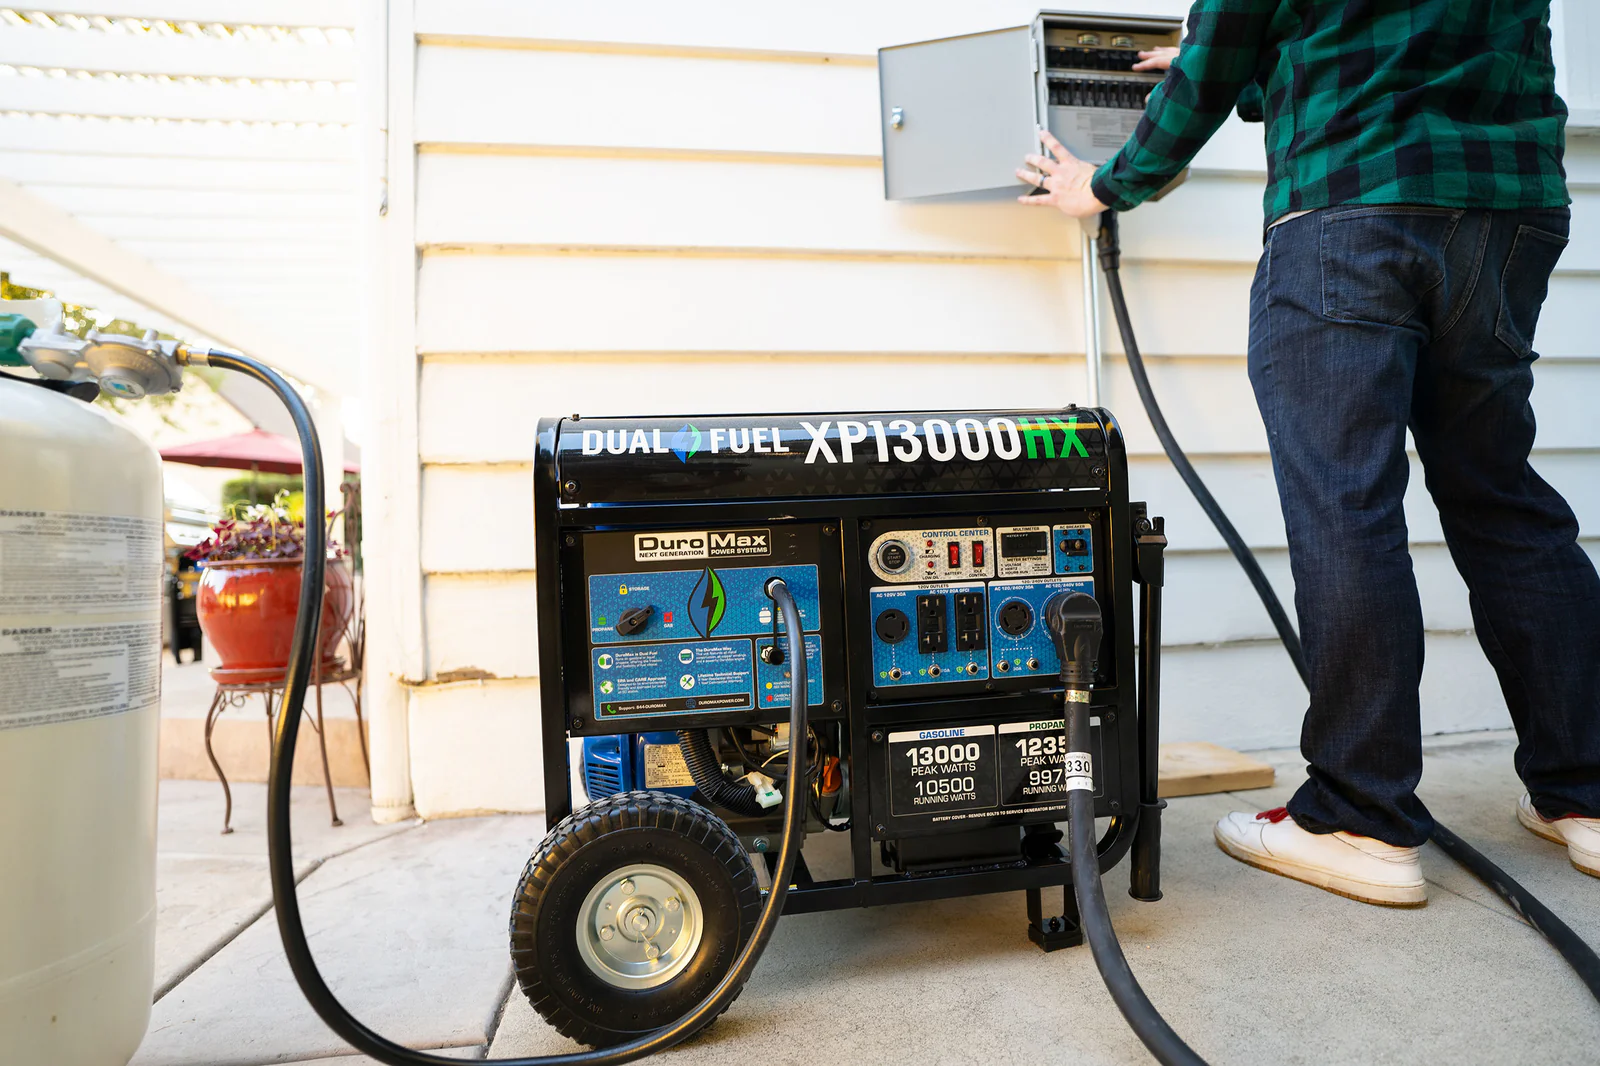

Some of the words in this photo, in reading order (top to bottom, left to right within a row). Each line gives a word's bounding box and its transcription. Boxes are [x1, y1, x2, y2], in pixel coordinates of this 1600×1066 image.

[582, 428, 669, 455] DUAL
[710, 426, 789, 454] FUEL
[799, 417, 1089, 464] XP13000HX
[2, 627, 52, 635] DANGER
[1029, 720, 1065, 730] PROPAN
[919, 729, 965, 739] GASOLINE
[1015, 736, 1066, 756] 1235
[906, 743, 980, 766] 13000
[1021, 756, 1046, 767] PEAK
[912, 765, 938, 776] PEAK
[940, 762, 976, 774] WATTS
[1029, 769, 1063, 785] 997
[915, 776, 974, 796] 10500
[1023, 784, 1056, 795] RUNNING
[914, 795, 948, 805] RUNNING
[950, 792, 976, 801] WATTS
